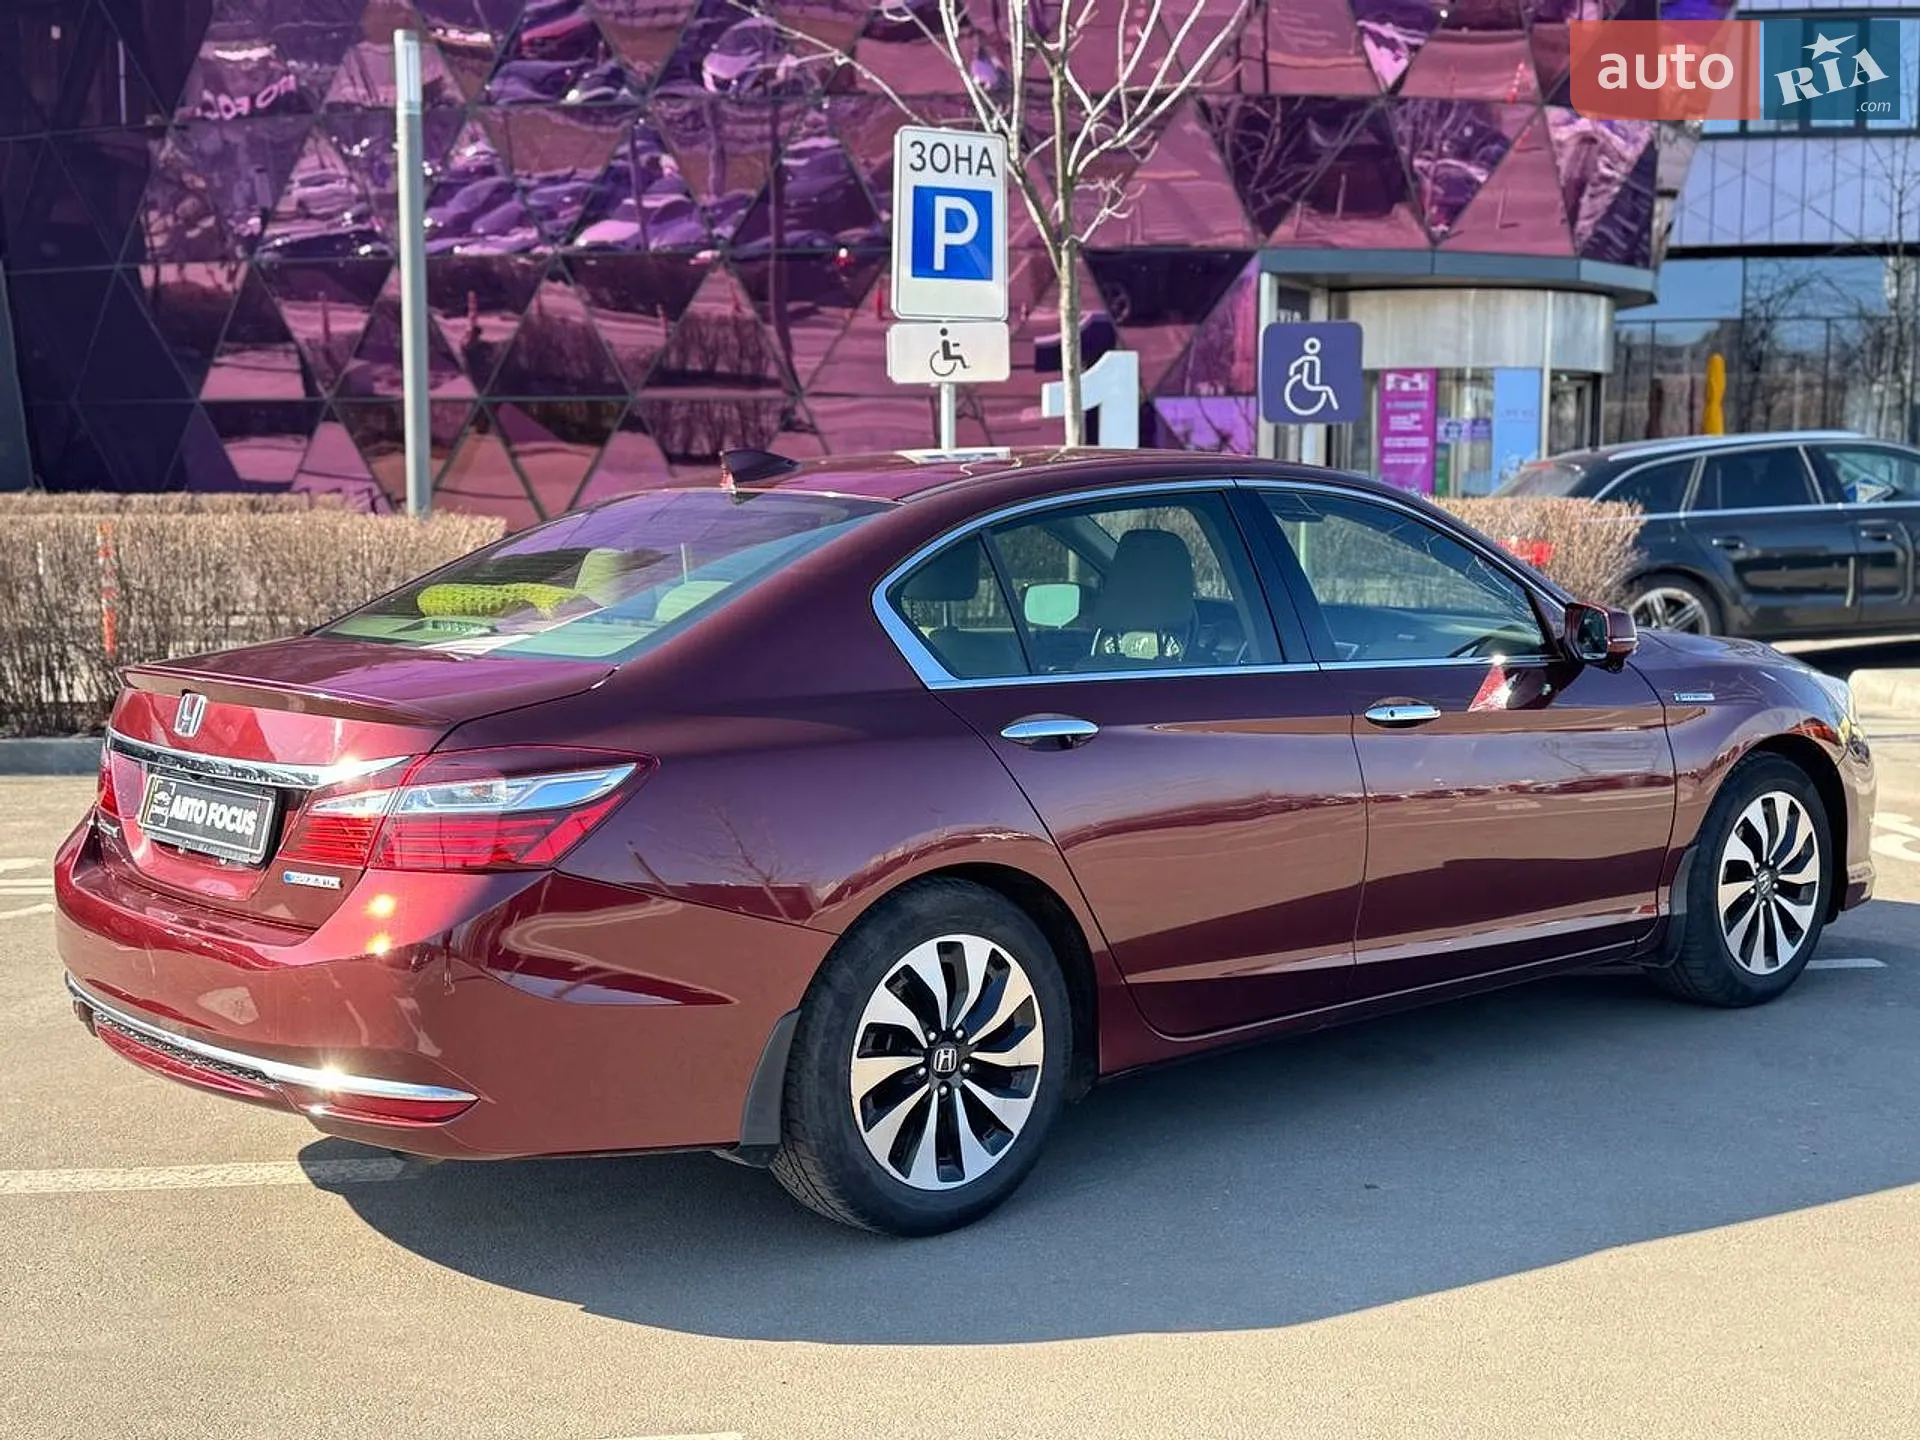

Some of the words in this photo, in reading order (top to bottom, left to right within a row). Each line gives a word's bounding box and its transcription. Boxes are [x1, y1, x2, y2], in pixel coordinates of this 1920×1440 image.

[909, 140, 996, 178] ЗОНА
[933, 195, 979, 271] P
[206, 802, 257, 835] FOCUS
